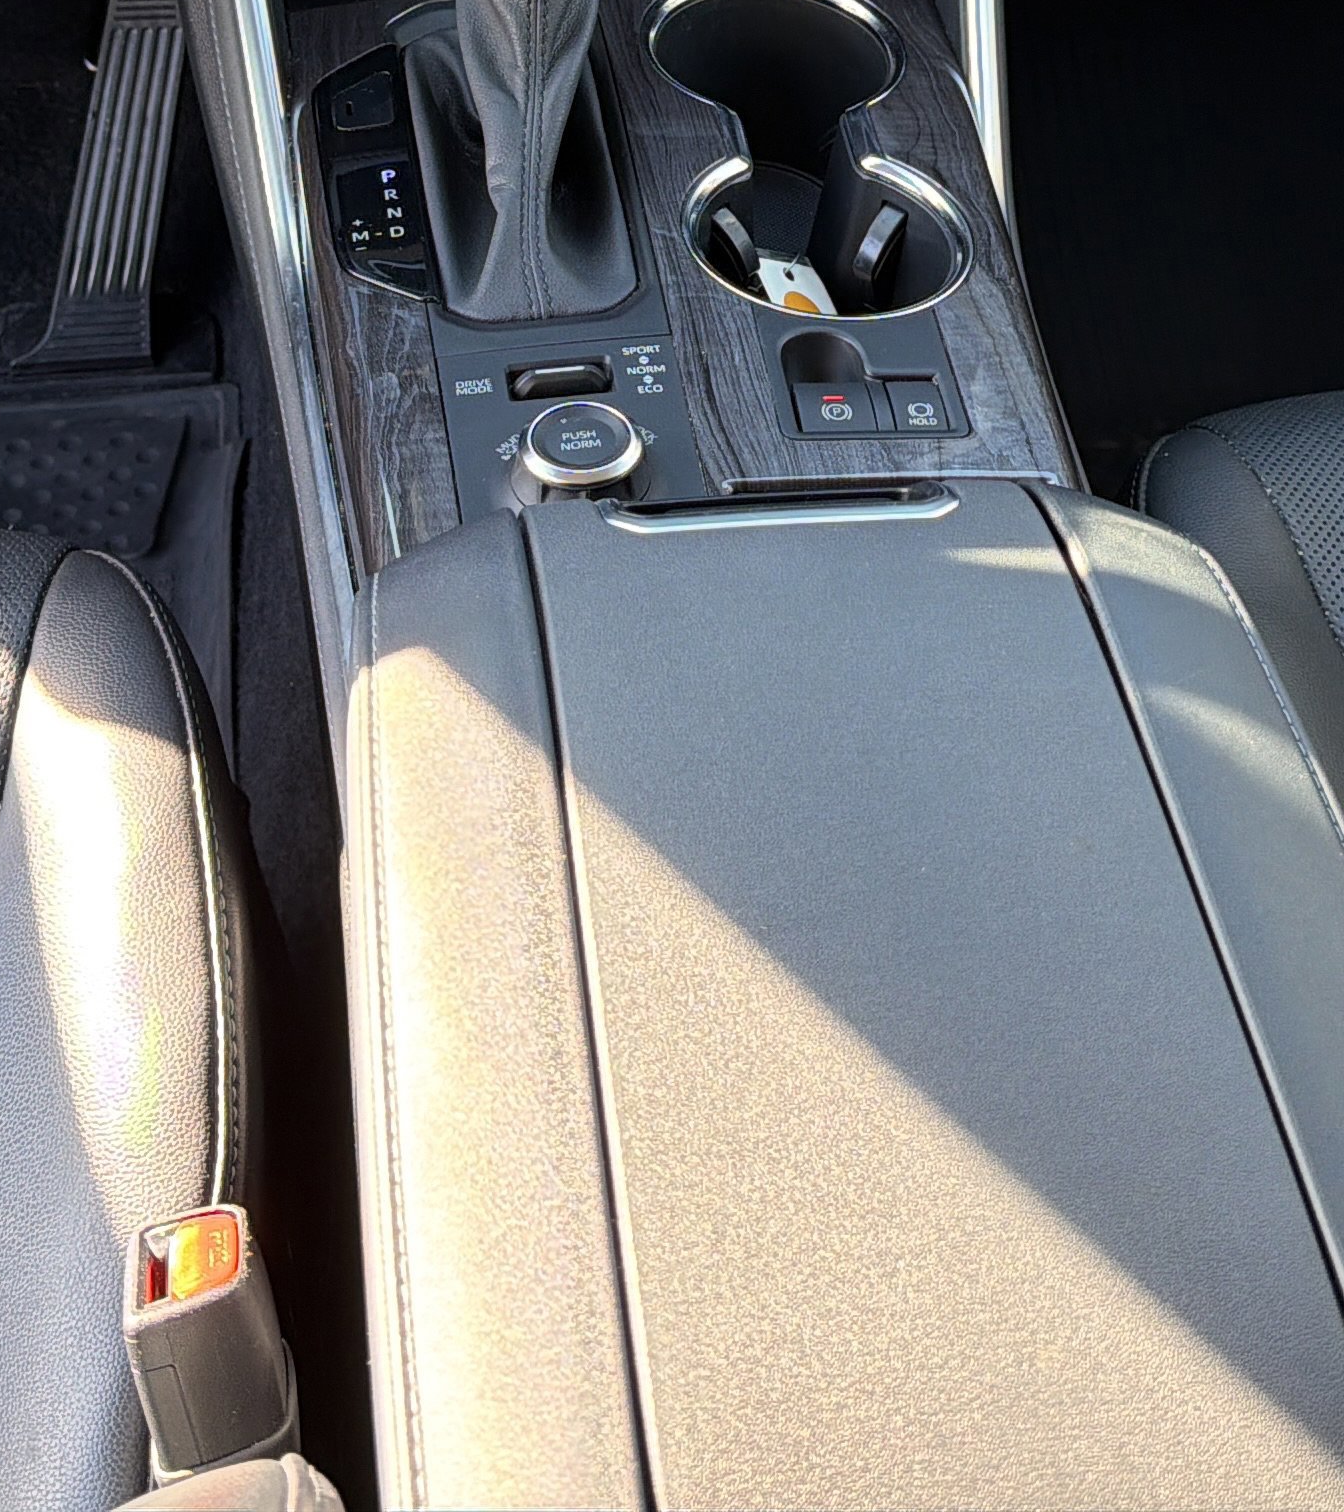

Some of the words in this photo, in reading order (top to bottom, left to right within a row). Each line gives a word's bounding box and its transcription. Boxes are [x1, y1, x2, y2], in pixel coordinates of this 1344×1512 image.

[380, 169, 396, 184] P
[383, 189, 400, 201] R
[387, 206, 403, 219] N
[352, 230, 370, 243] M
[389, 226, 405, 238] D
[621, 344, 661, 356] SPORT
[626, 364, 666, 376] NORM
[455, 378, 492, 389] DRIVE
[637, 383, 664, 394] ECO
[456, 386, 494, 396] MODE
[908, 417, 938, 426] HOLD
[561, 429, 597, 440] PUSH
[560, 438, 602, 451] NORM
